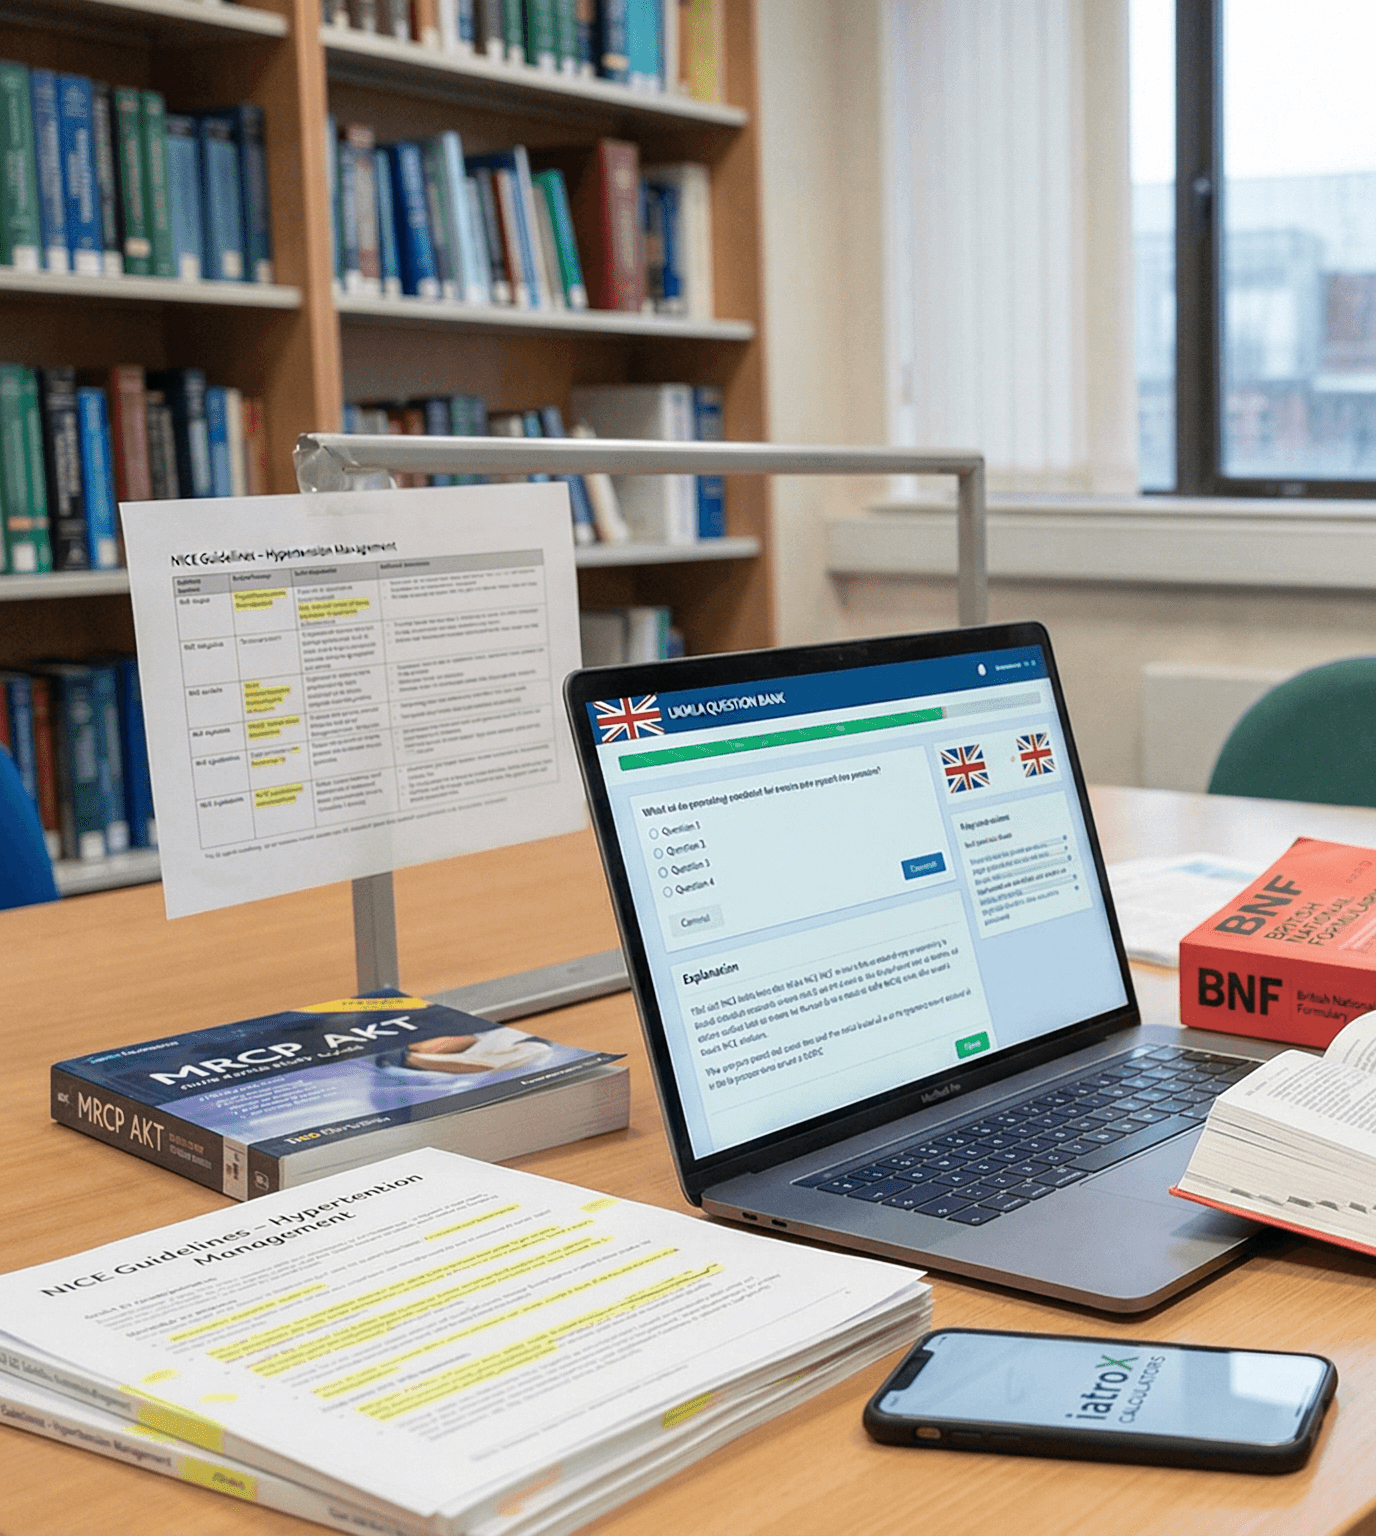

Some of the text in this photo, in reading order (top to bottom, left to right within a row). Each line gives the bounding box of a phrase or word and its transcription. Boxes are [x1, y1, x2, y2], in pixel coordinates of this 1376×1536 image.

[706, 695, 758, 716] QUESTION
[758, 691, 786, 707] BANK
[1213, 873, 1303, 936] BNF
[1198, 966, 1283, 1017] BNF
[149, 1041, 303, 1086] MRCP
[323, 1015, 419, 1049] AKT
[77, 1091, 126, 1134] MRCP
[129, 1113, 165, 1152] AKT
[39, 1271, 117, 1298] NICE
[113, 1228, 252, 1276] Guidelines
[193, 1210, 357, 1267] Management
